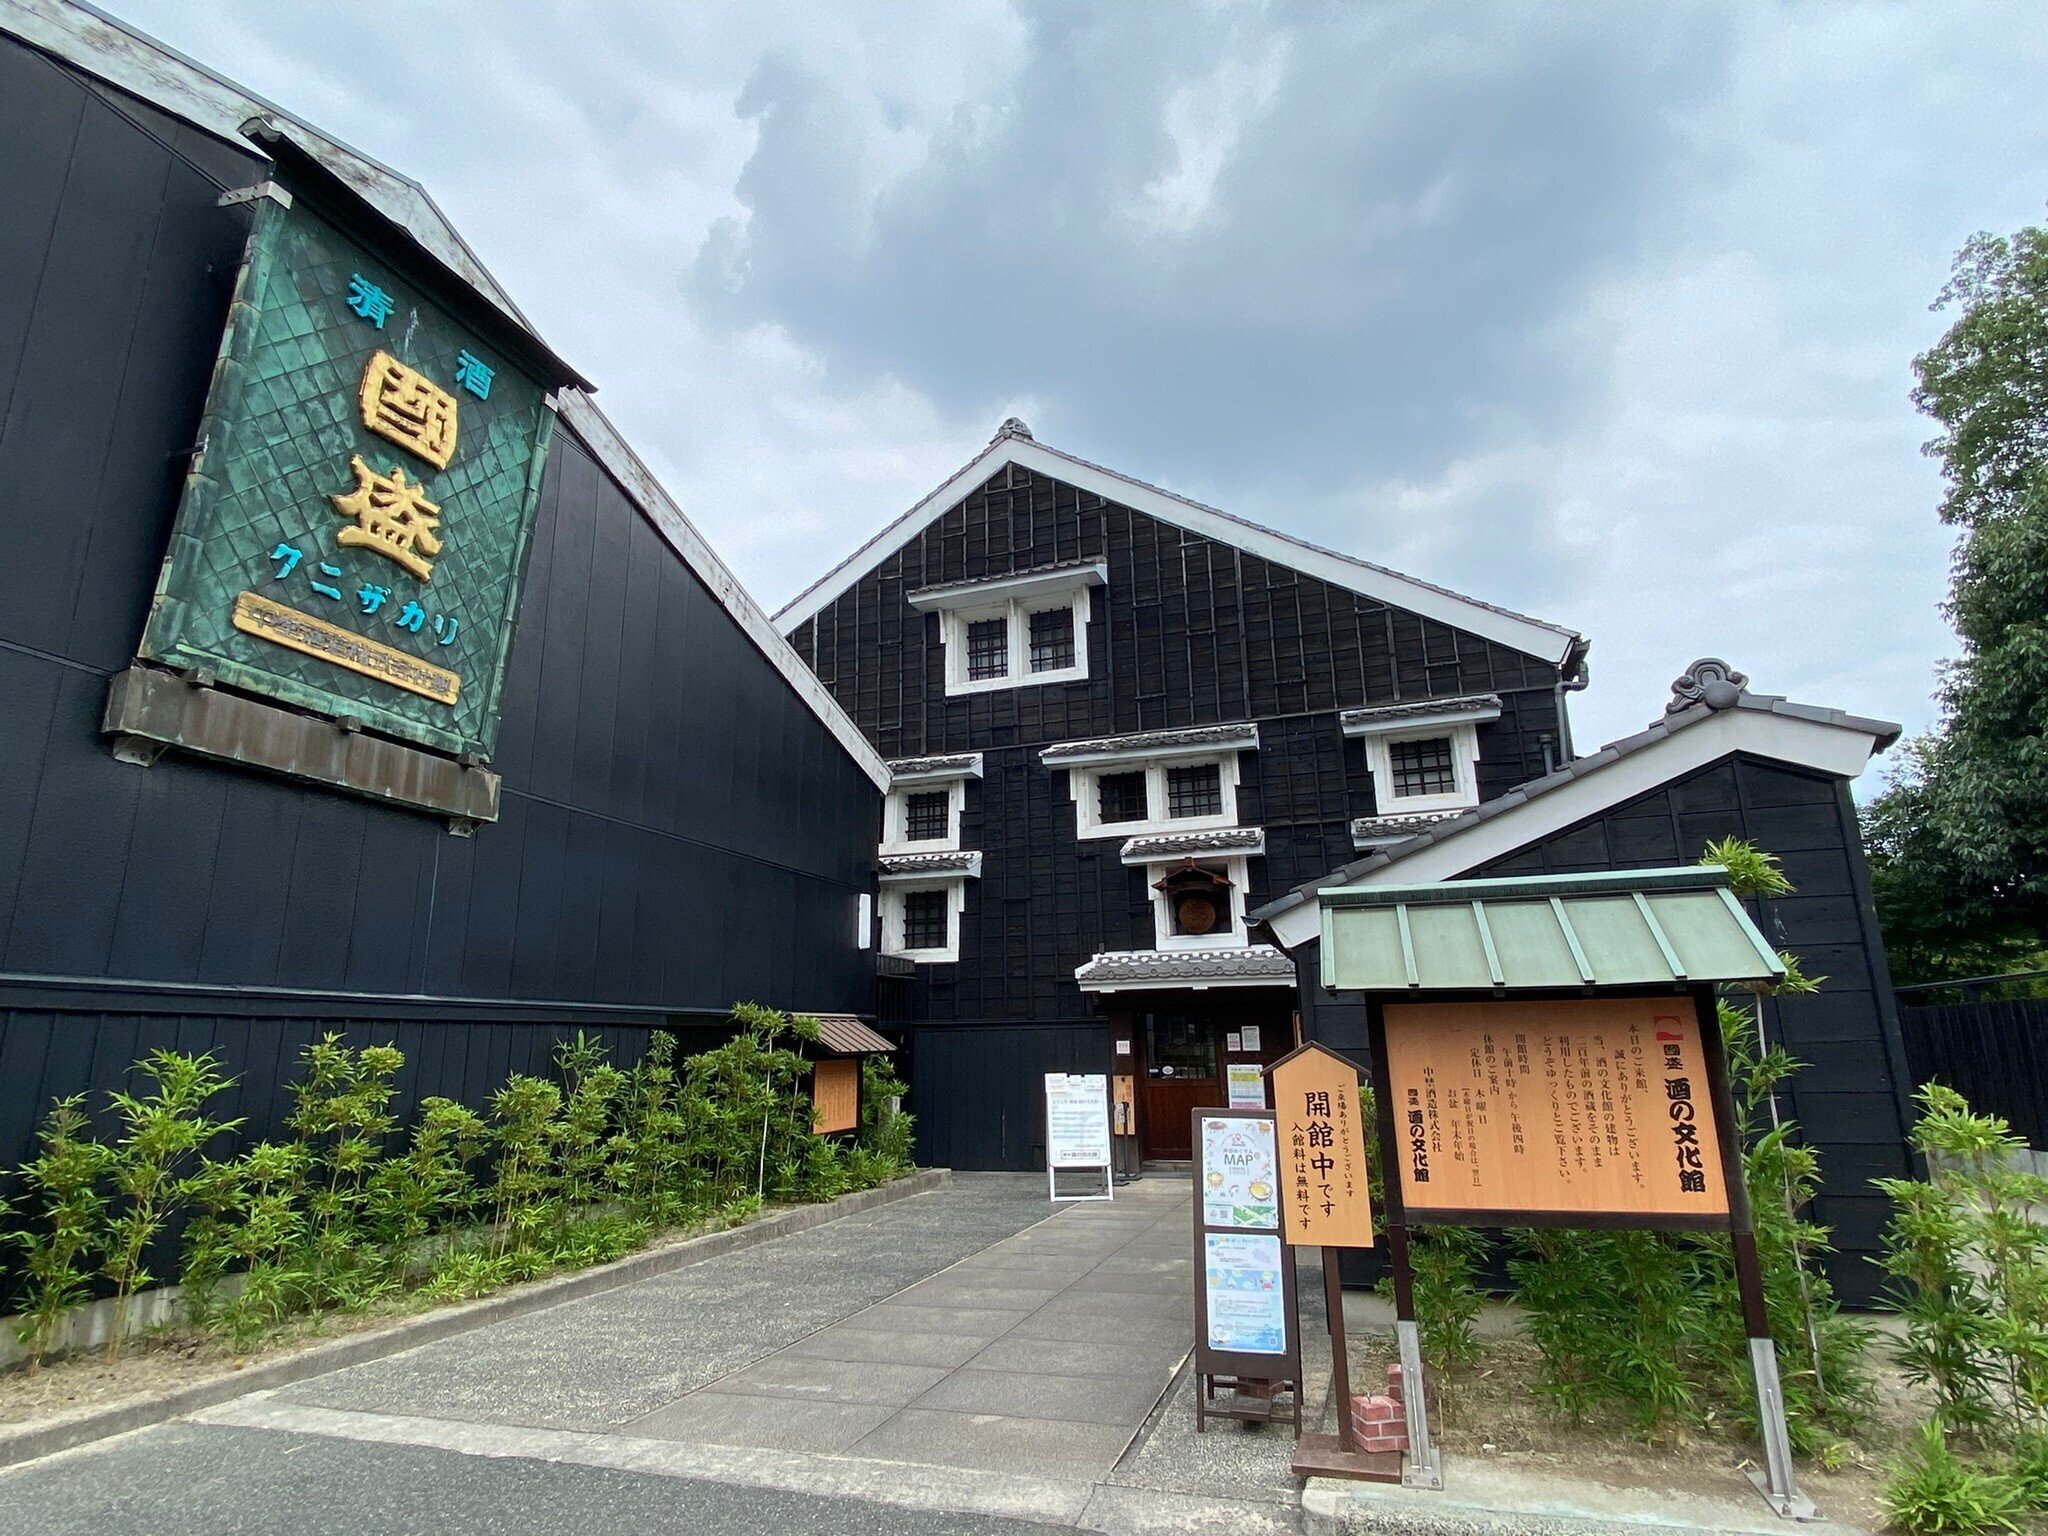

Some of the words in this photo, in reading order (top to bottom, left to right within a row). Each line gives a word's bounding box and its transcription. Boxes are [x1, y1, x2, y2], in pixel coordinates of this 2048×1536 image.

[270, 543, 459, 646] クニザカリ
[1470, 1047, 1482, 1078] 定休日
[1484, 1033, 1500, 1096] 休館のご案内
[1515, 1033, 1530, 1075] 開館時間
[1223, 1153, 1254, 1166] MAP
[1304, 1091, 1336, 1218] 開館中です
[1407, 1109, 1430, 1183] 酒の文化館
[1664, 1077, 1706, 1193] 酒の文化館
[1291, 1122, 1311, 1230] 入館料は無料です
